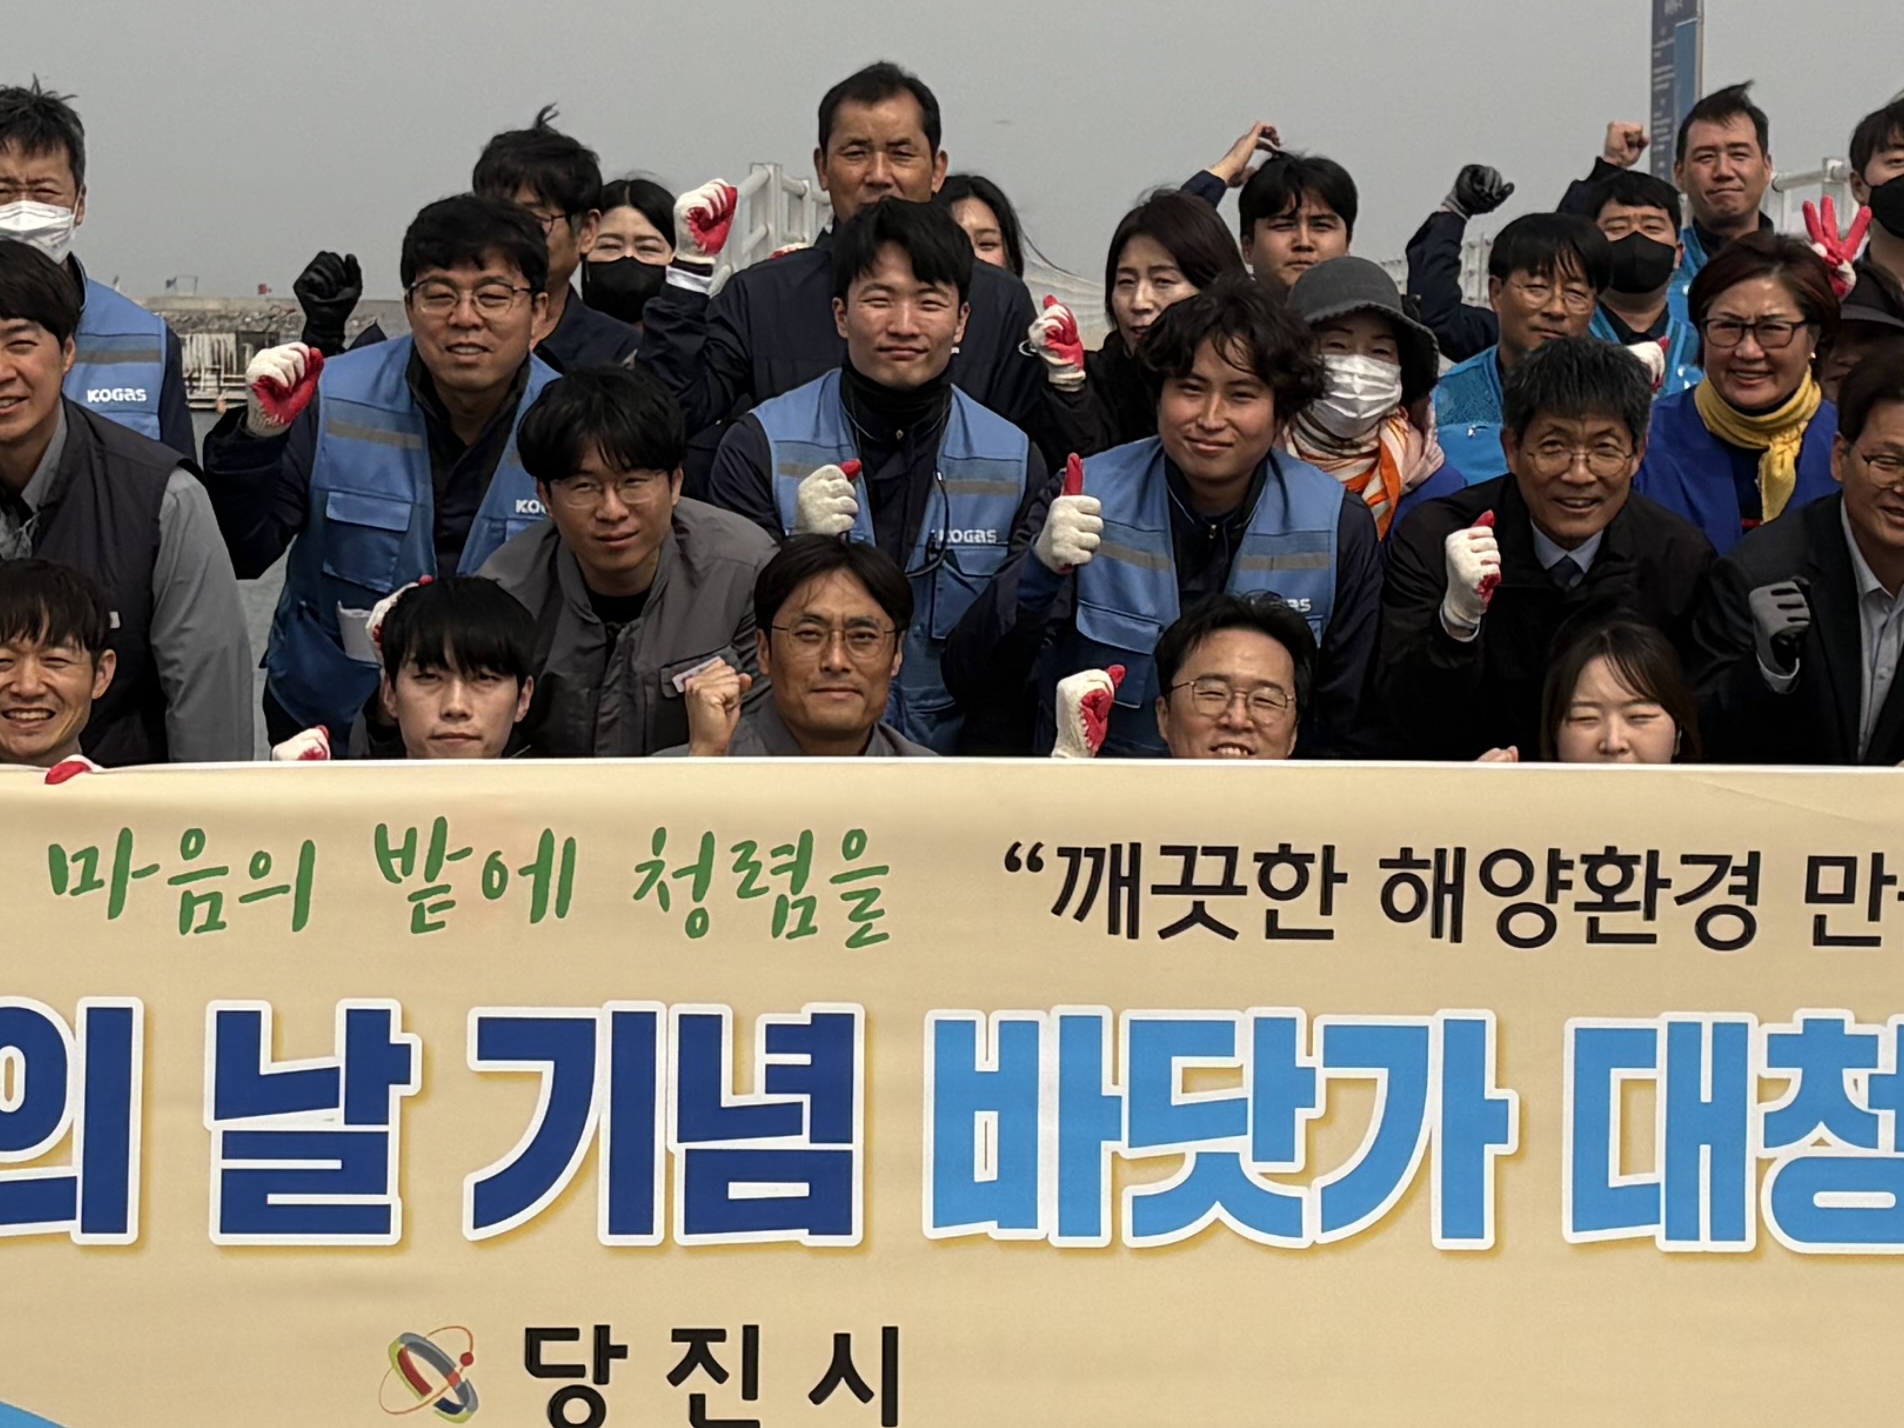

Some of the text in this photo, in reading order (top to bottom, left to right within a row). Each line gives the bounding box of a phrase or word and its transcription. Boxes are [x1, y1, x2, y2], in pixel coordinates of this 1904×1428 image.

[49, 828, 315, 933] 마음의
[375, 817, 575, 934] 밭에
[636, 828, 890, 949] 청렴을
[1378, 845, 1761, 951] 해양환경
[213, 1008, 412, 1235] 날
[472, 1010, 854, 1237] 기념
[932, 1013, 1510, 1241] 바닷가
